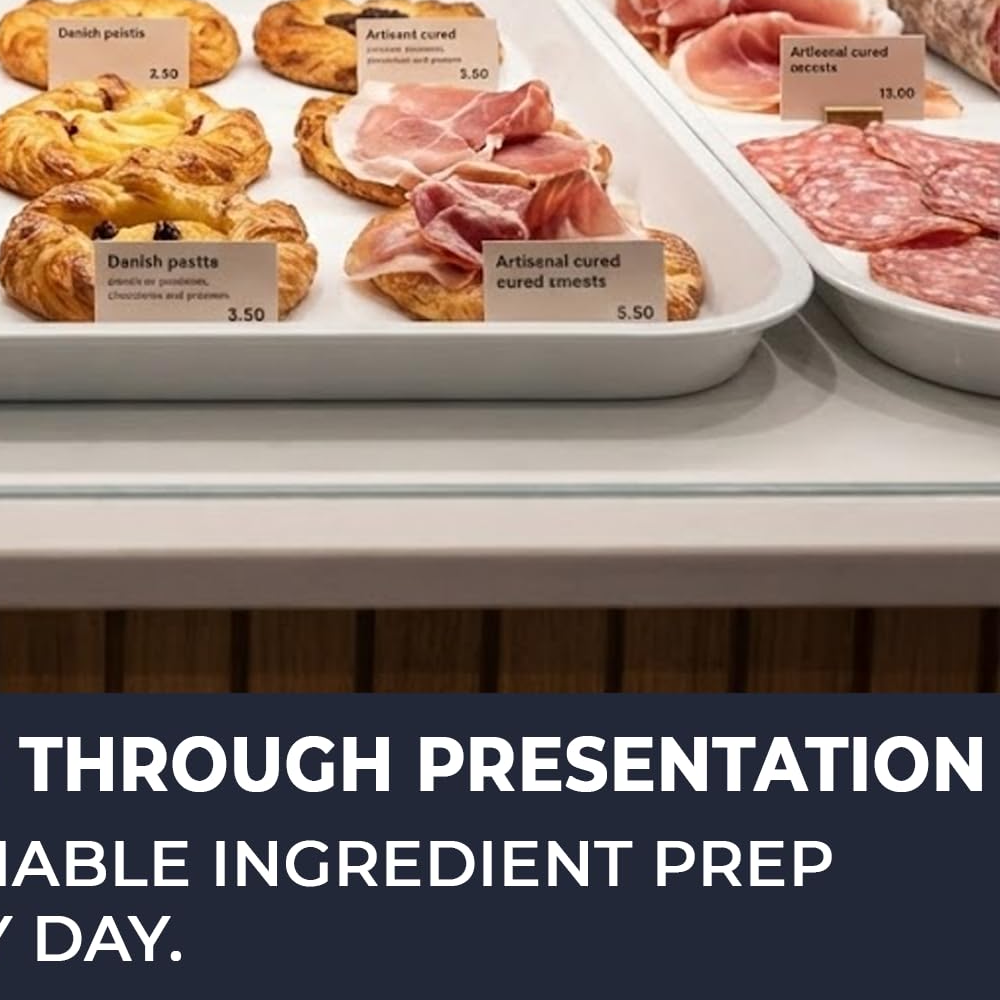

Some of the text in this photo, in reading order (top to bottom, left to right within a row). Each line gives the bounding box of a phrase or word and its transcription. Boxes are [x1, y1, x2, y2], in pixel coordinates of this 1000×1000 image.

[420, 28, 457, 40] cured
[851, 46, 889, 58] cured
[149, 68, 179, 79] 2.50
[879, 87, 915, 99] 13.00
[573, 254, 621, 268] cured
[497, 275, 544, 289] cured
[227, 307, 265, 322] 3.50
[617, 305, 655, 320] 5.50
